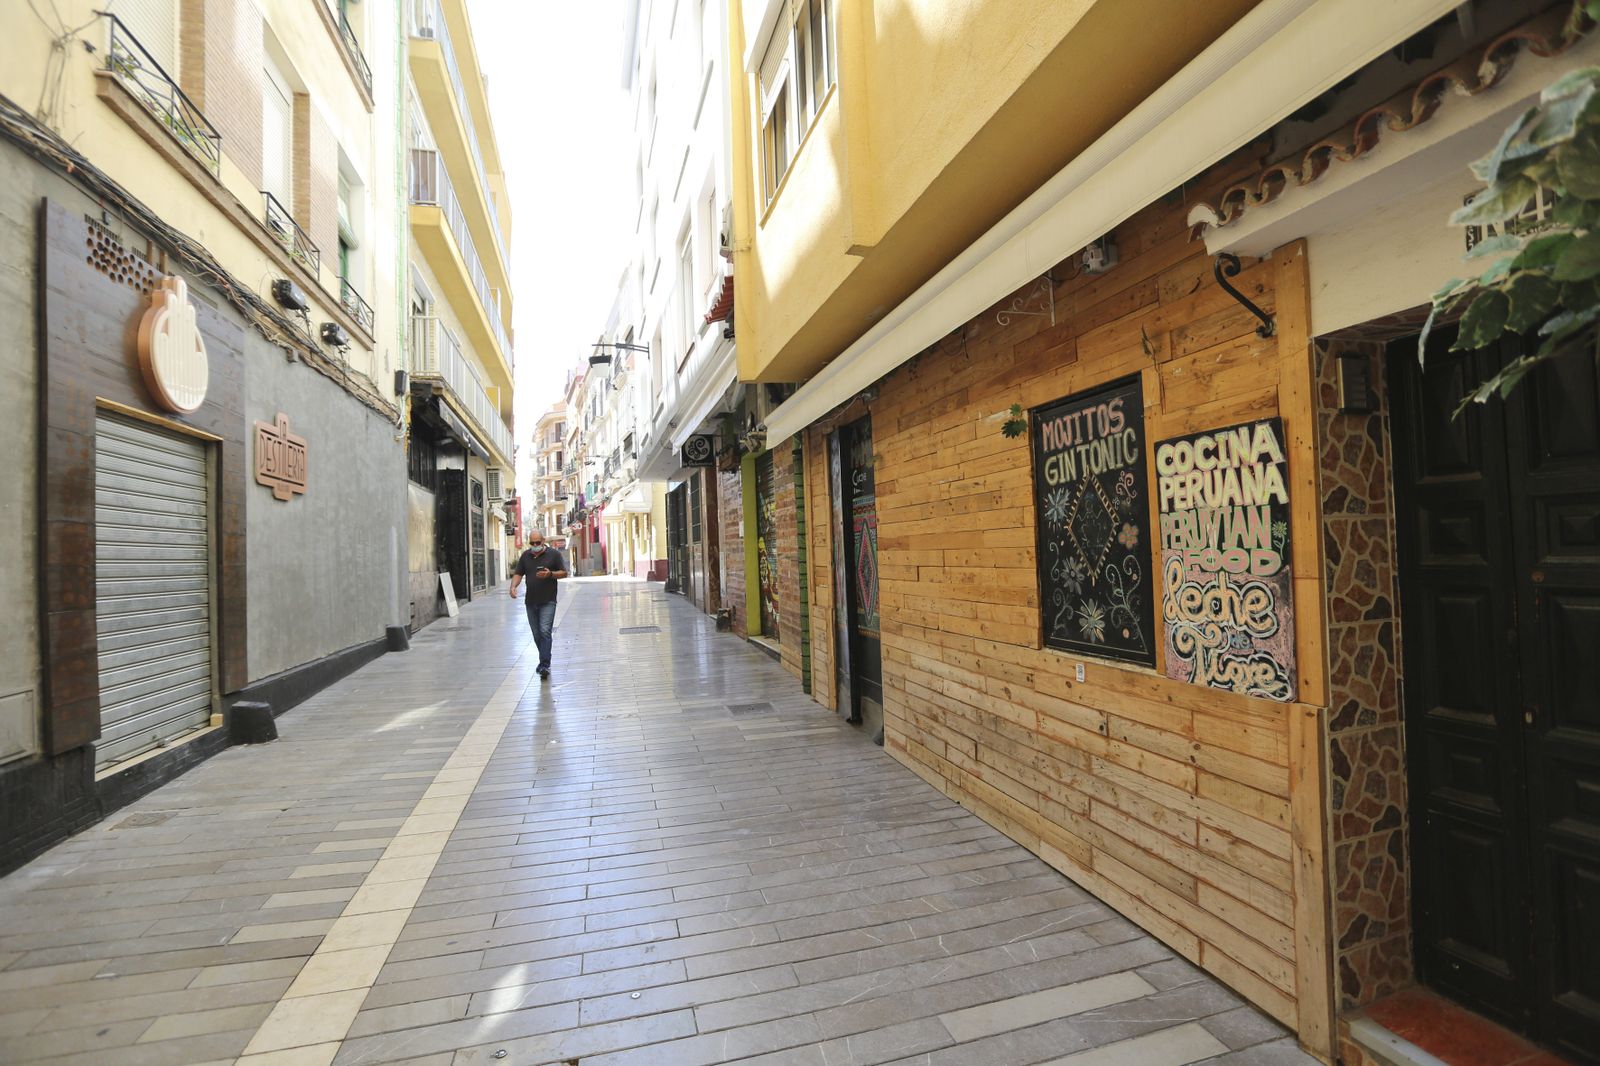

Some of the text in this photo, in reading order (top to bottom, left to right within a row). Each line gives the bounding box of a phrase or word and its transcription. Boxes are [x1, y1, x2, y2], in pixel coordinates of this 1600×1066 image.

[1042, 397, 1125, 453] MOJITOS
[1156, 422, 1287, 477] COCINA
[1044, 427, 1139, 486] GIN TONIC
[1159, 461, 1290, 513] PERUANA
[1160, 505, 1272, 551] PERUVIAN
[1182, 548, 1282, 577] FOOD
[1164, 557, 1278, 637] Leche
